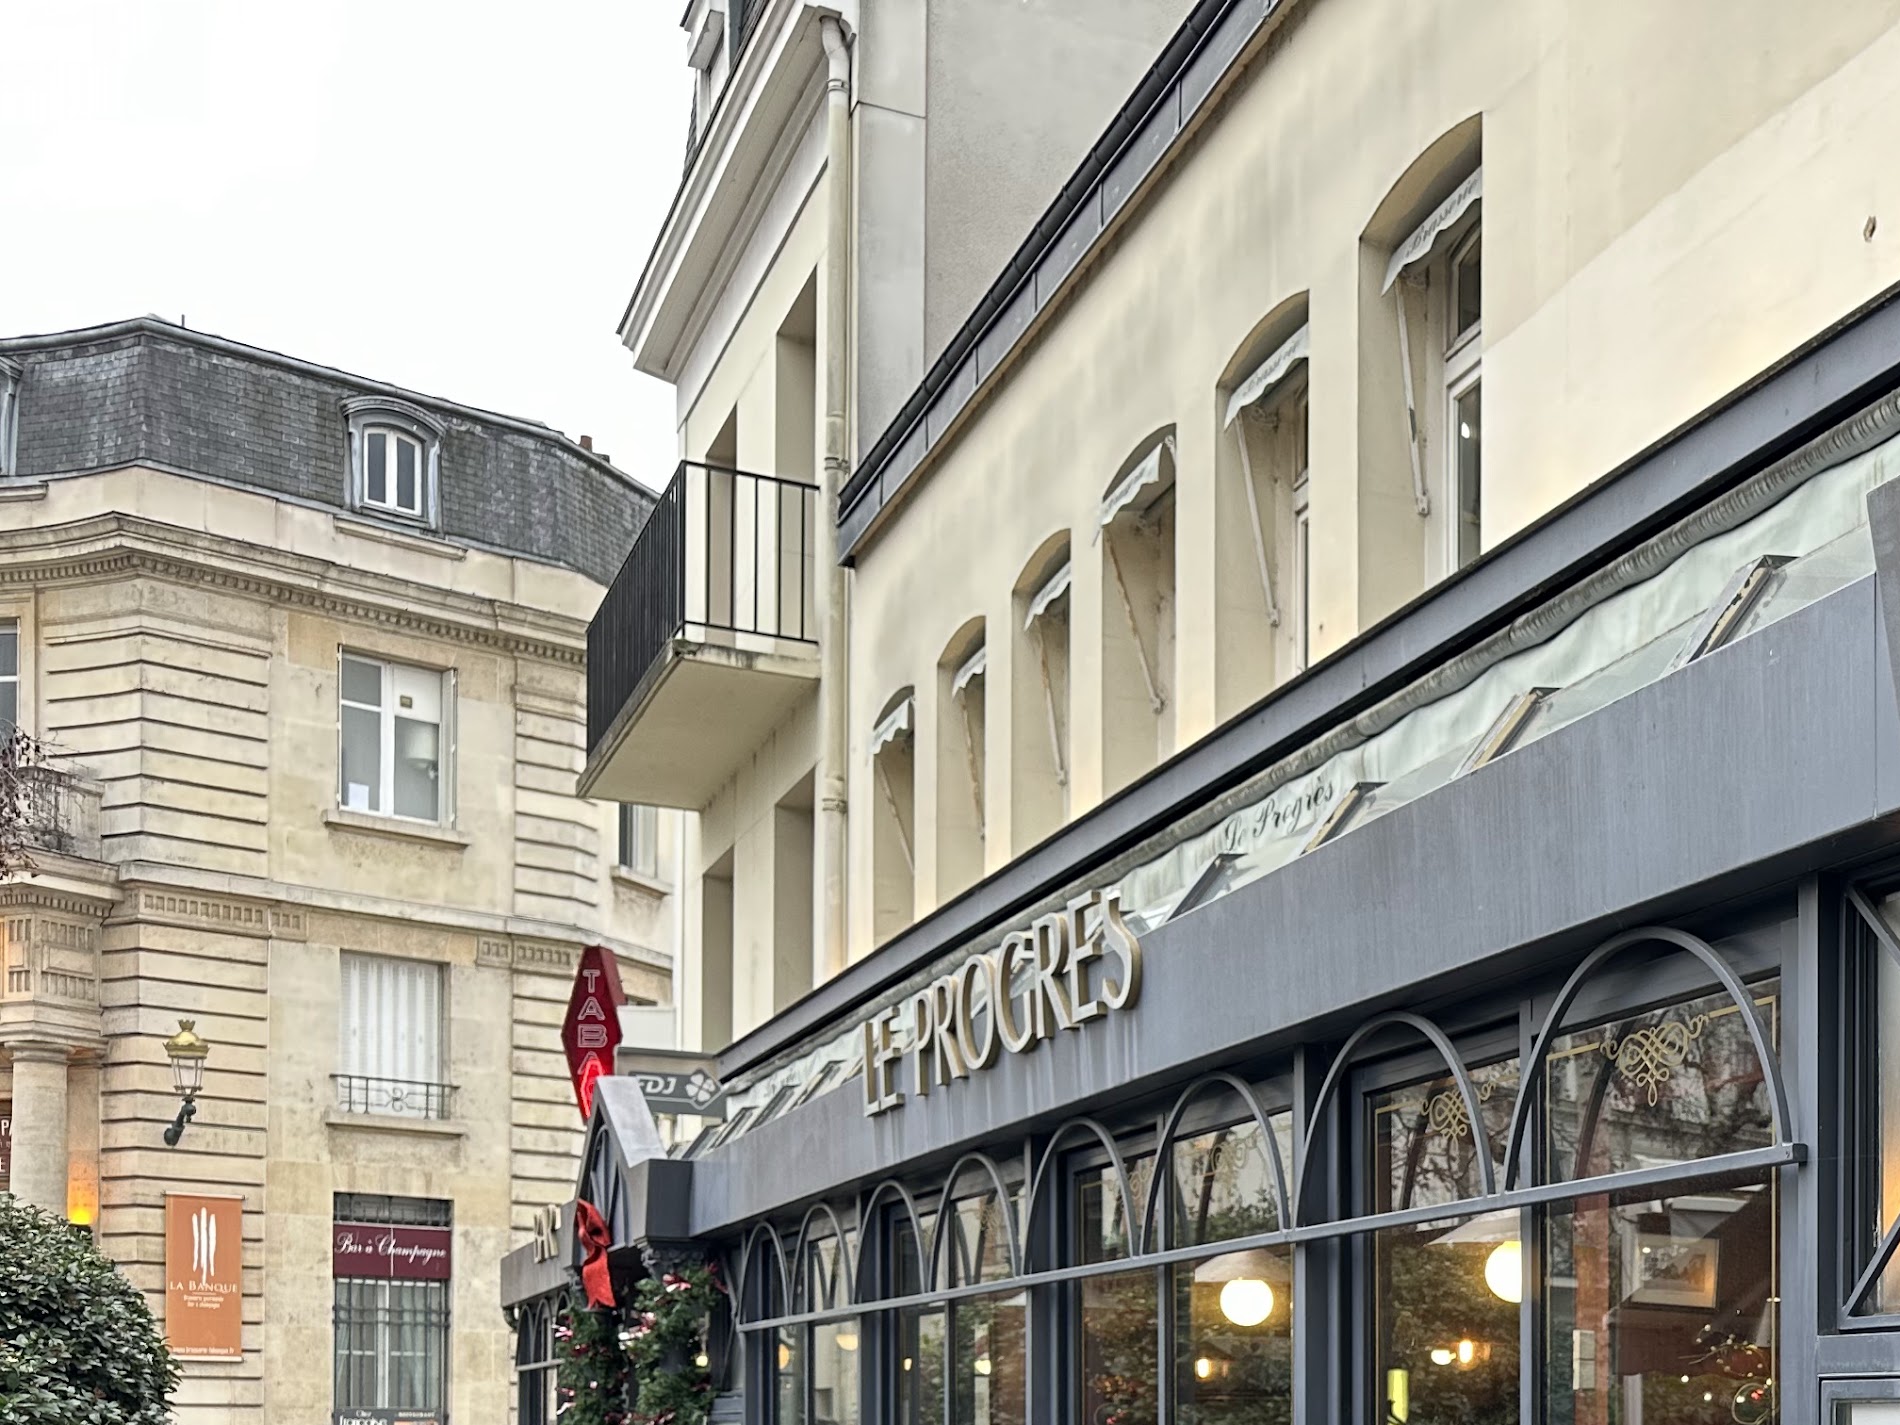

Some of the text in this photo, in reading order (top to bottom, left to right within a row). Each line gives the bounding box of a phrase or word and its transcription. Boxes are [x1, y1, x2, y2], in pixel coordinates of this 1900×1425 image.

[577, 969, 608, 1084] TABA
[863, 885, 1142, 1117] LE PROGRES
[375, 1234, 447, 1265] Champagne
[170, 1281, 237, 1293] LA BANQUE
